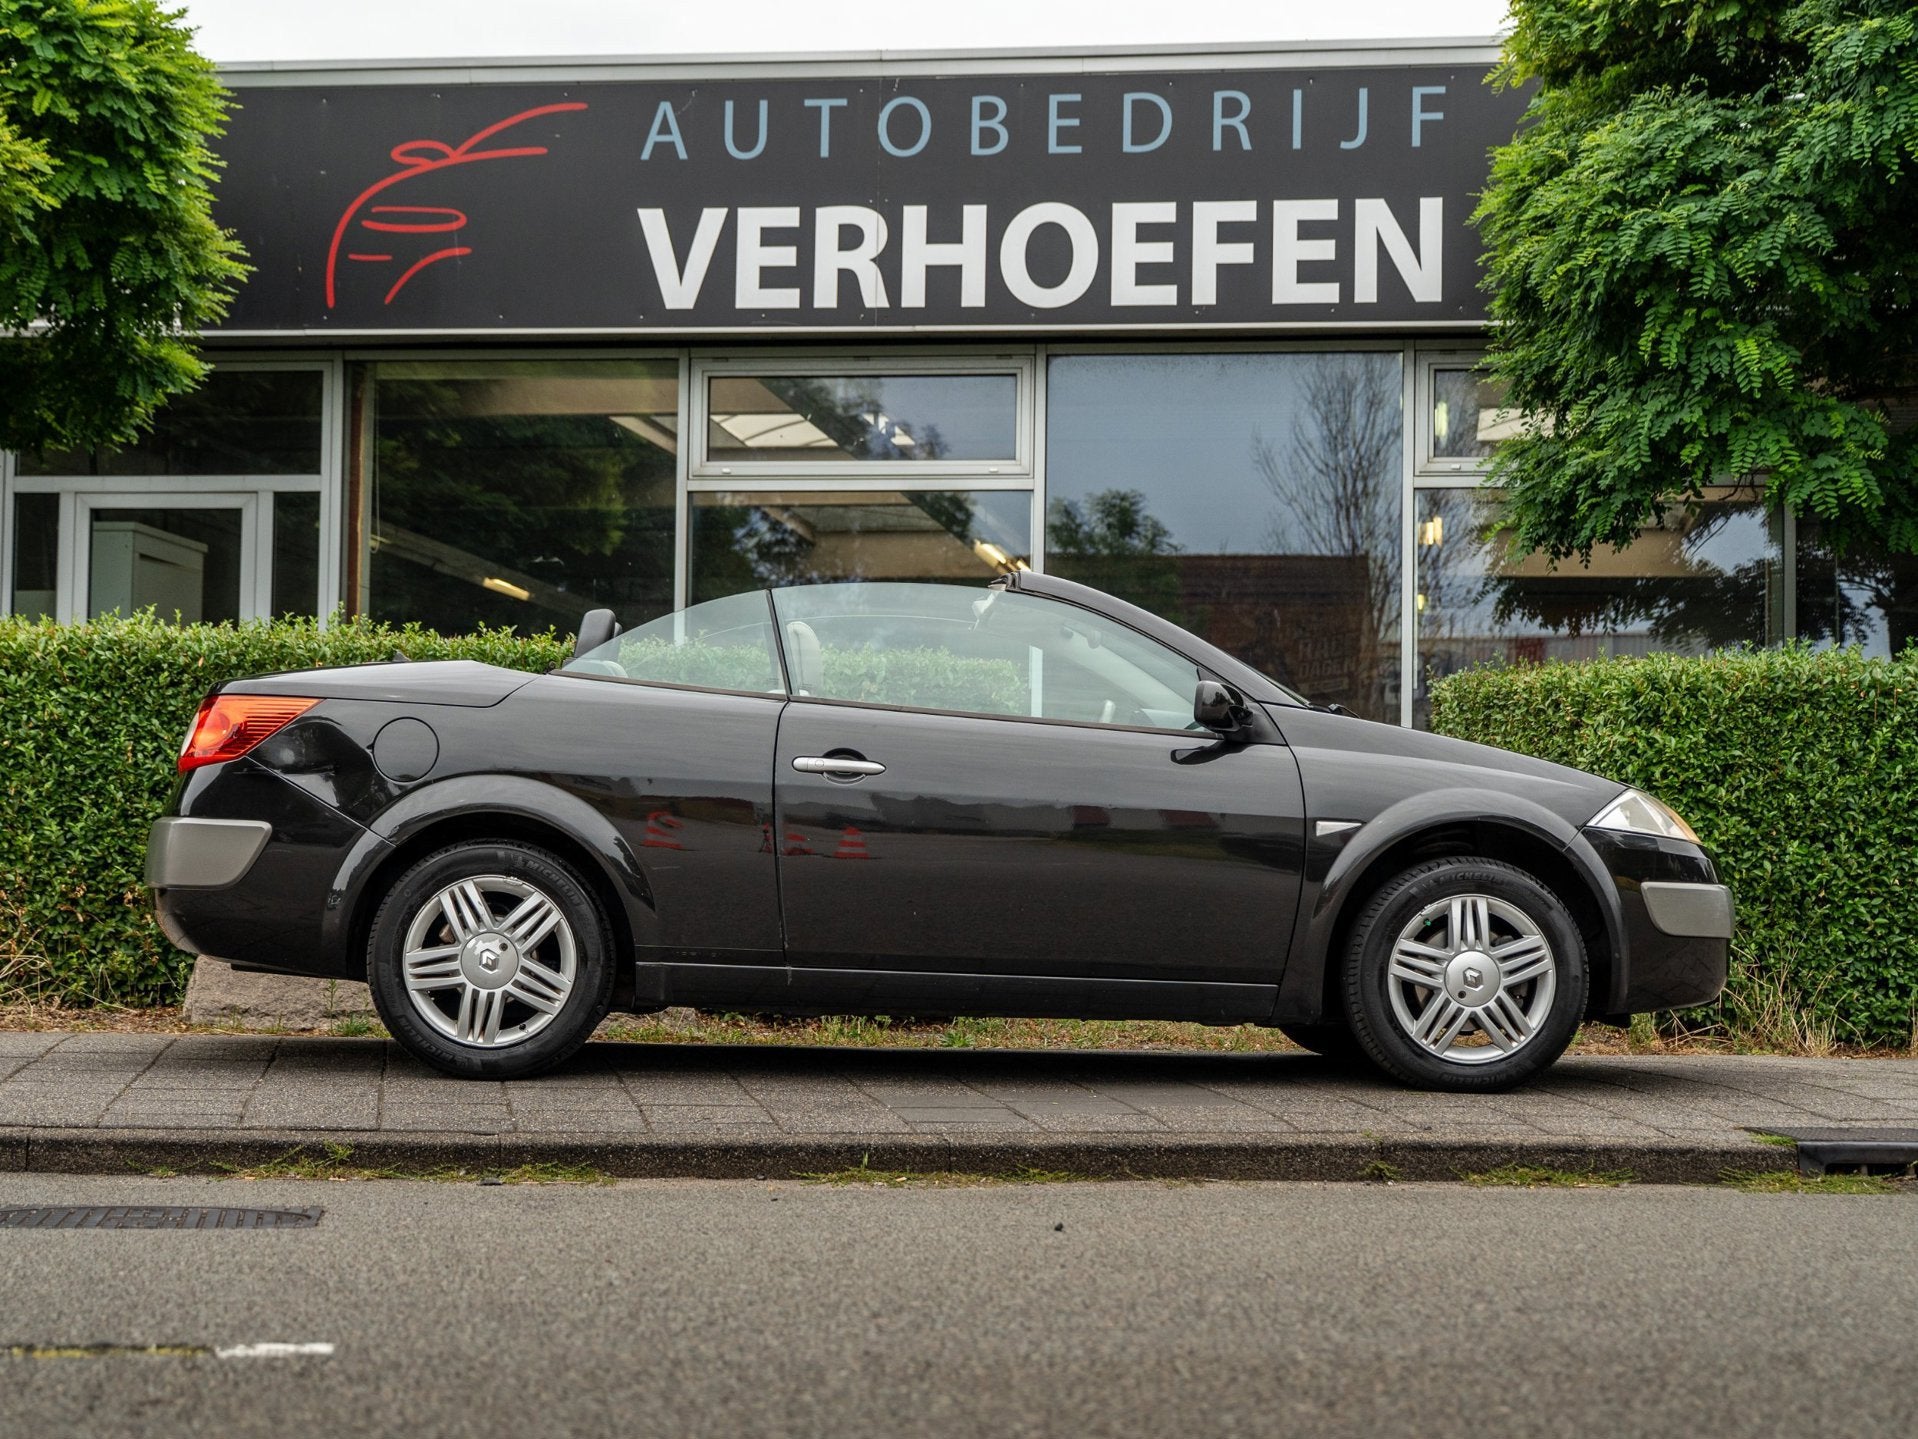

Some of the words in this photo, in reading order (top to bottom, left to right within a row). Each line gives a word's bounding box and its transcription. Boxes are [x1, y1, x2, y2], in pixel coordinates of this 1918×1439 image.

[640, 85, 1448, 162] AUTOBEDRIJF
[637, 196, 1444, 311] VERHOEFEN
[525, 859, 585, 906] MICHELIN
[1439, 870, 1507, 887] MICHELIN
[397, 1015, 455, 1062] MICHELIN
